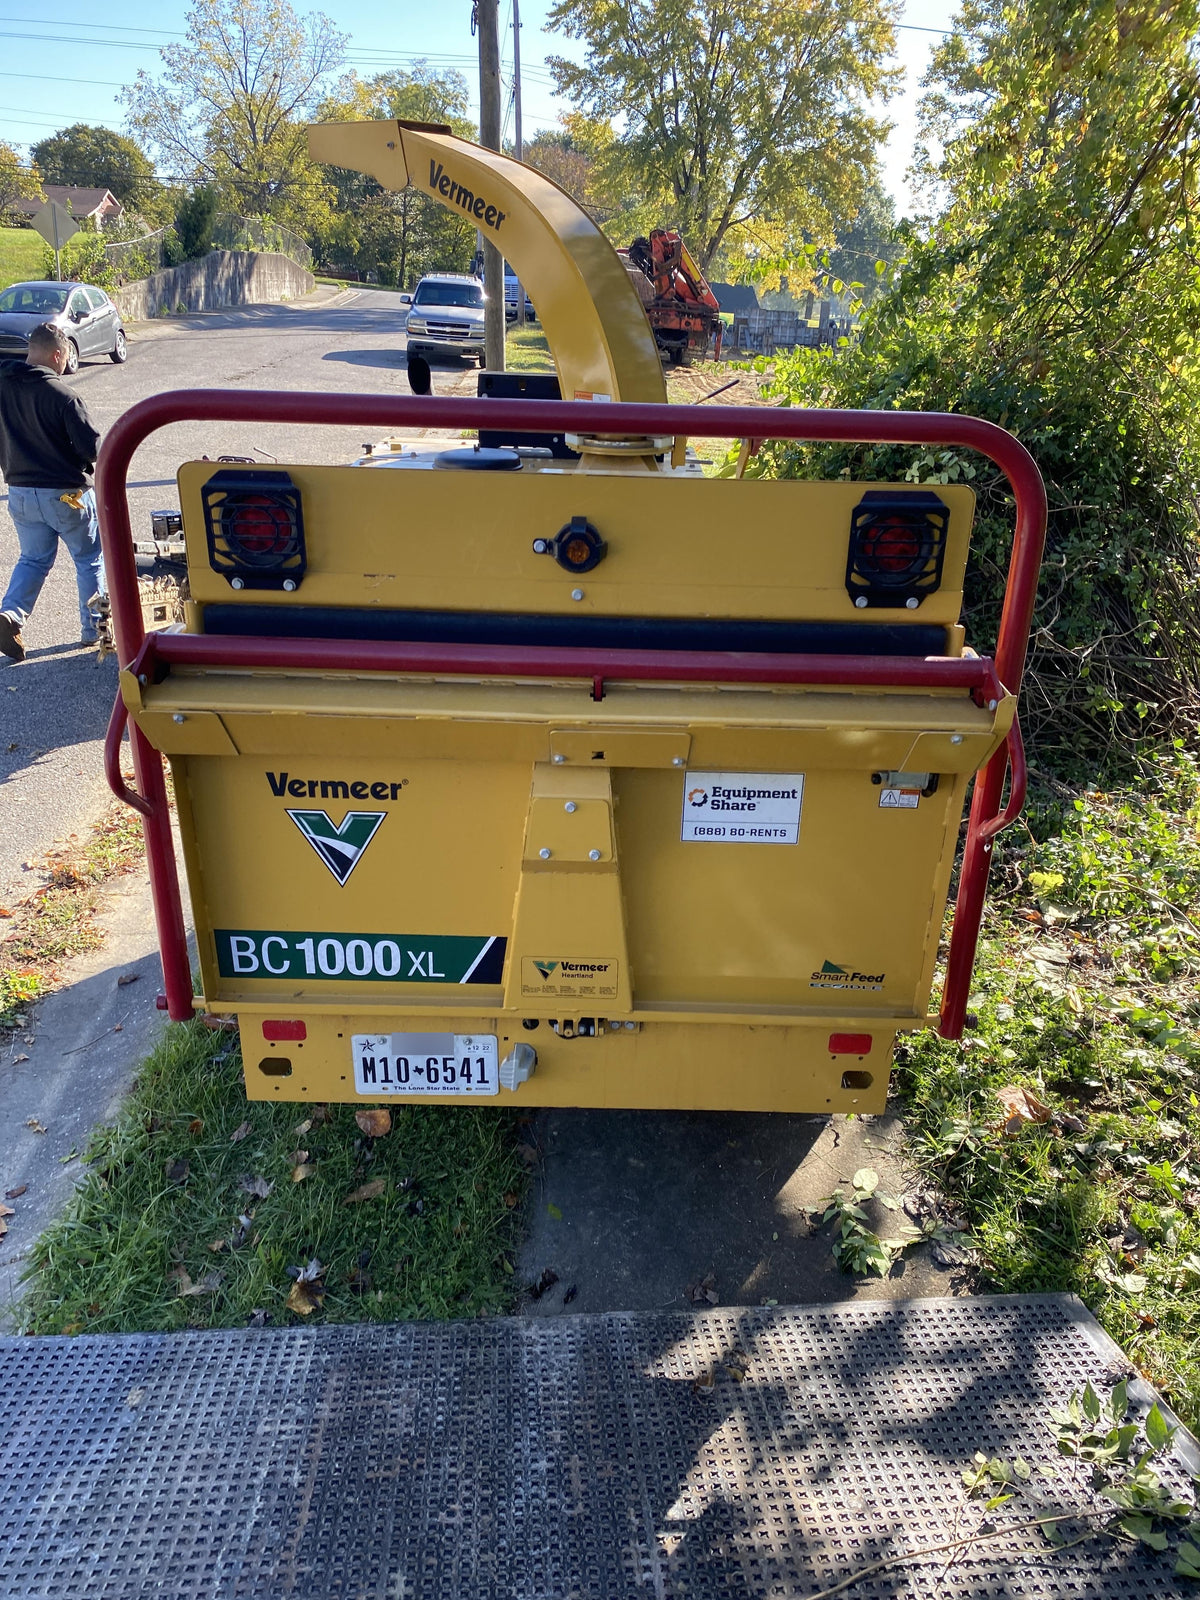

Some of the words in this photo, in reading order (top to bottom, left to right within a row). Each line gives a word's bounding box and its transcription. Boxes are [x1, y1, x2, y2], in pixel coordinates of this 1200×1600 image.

[430, 158, 506, 232] Vermeer
[265, 772, 402, 800] Vermeer
[711, 786, 798, 800] Equipment
[710, 800, 756, 811] Share
[694, 826, 726, 836] (888)
[730, 828, 787, 838] 80-RENTS
[407, 951, 446, 978] XL
[560, 961, 608, 972] Vermeer
[362, 1057, 410, 1084] M10
[426, 1057, 490, 1084] 6541
